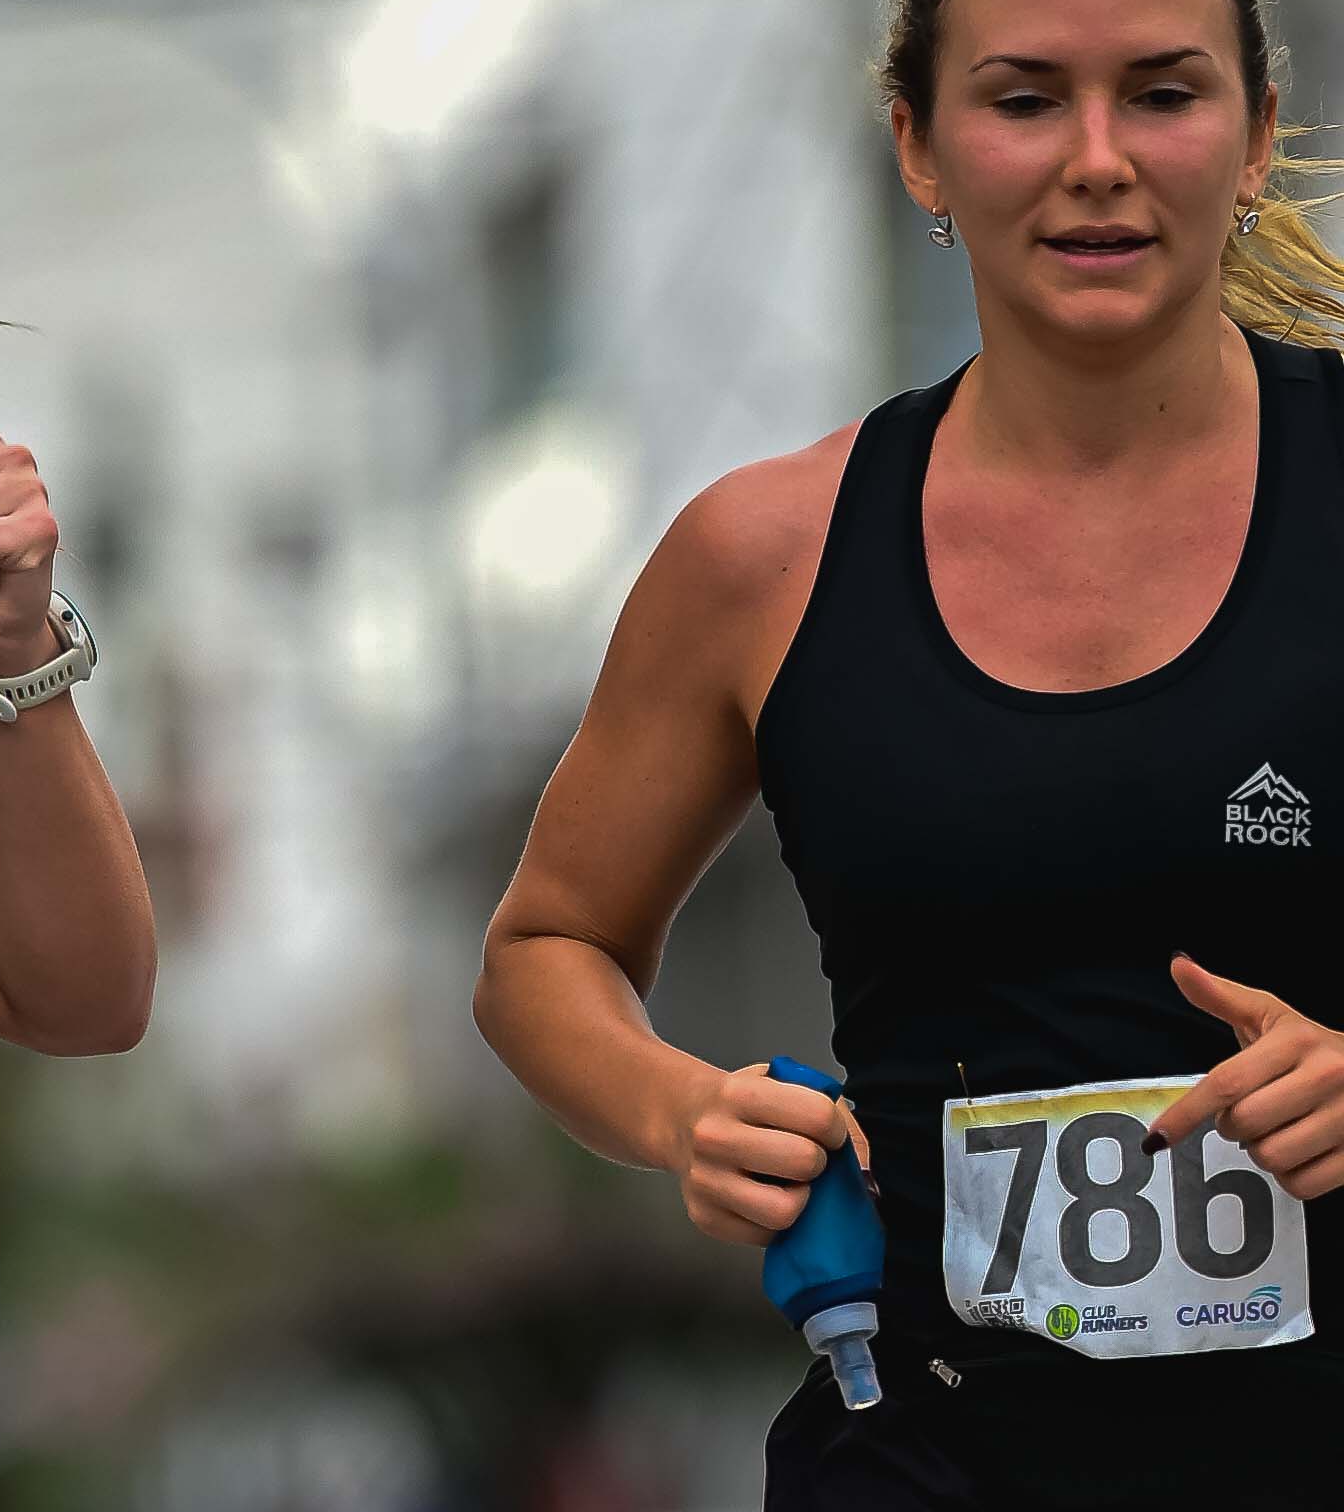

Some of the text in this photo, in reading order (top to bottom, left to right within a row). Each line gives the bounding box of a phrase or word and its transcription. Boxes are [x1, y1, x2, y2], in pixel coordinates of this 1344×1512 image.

[1226, 804, 1312, 826] BLACK
[1225, 823, 1312, 847] ROCK
[964, 1111, 1274, 1295] 786
[1082, 1305, 1116, 1319] CLUB
[1176, 1300, 1280, 1327] CARUSO
